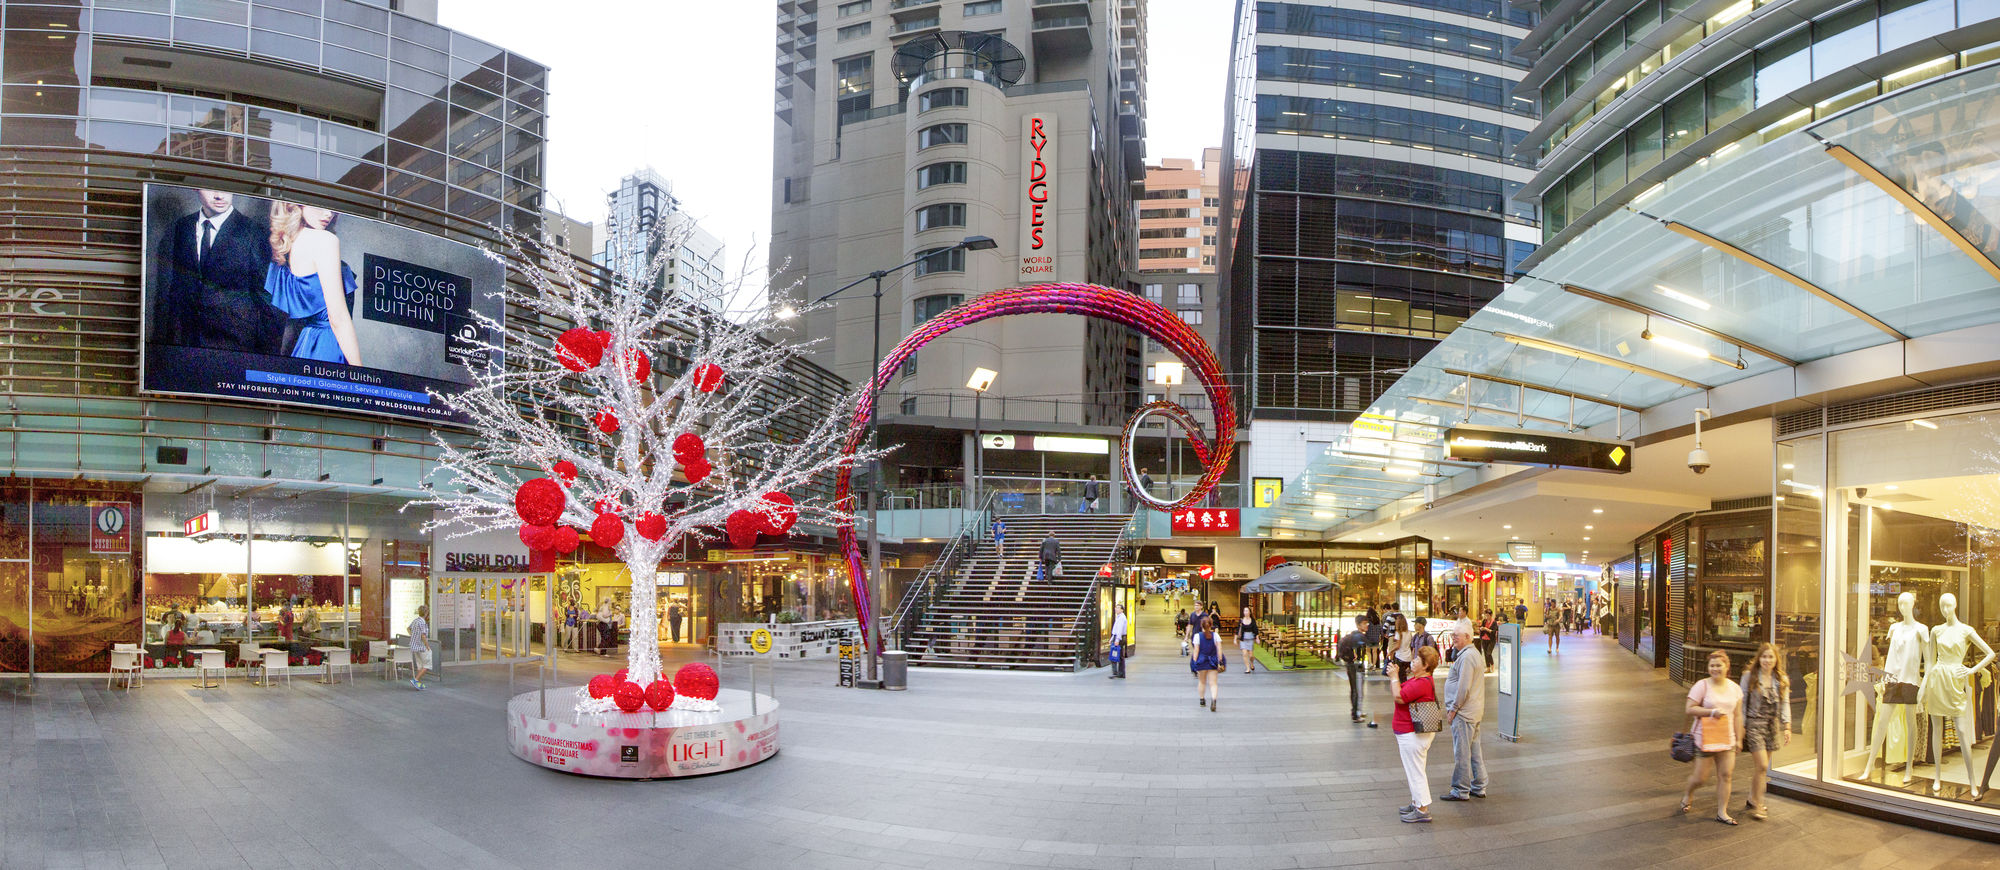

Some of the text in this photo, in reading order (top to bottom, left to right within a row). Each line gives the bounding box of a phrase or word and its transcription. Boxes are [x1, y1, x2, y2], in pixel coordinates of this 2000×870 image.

[1028, 117, 1048, 250] RYDGES
[1021, 265, 1054, 274] SQUARE
[1023, 256, 1053, 264] WORLD
[374, 265, 457, 297] DISCOVER
[374, 281, 454, 311] A WORLD
[374, 296, 435, 323] WITHIN
[303, 364, 382, 384] A World Within
[216, 382, 236, 390] STAY
[238, 384, 280, 394] INFORMED,
[282, 388, 300, 396] JOIN
[301, 390, 316, 398] THE
[374, 399, 452, 416] WORLDSQUARE.COM.AU
[266, 374, 413, 400] Style Food Glamour Service Lifestyle
[445, 552, 491, 567] SUSHI
[1335, 561, 1380, 575] BURGERS
[672, 738, 727, 762] LIGHT
